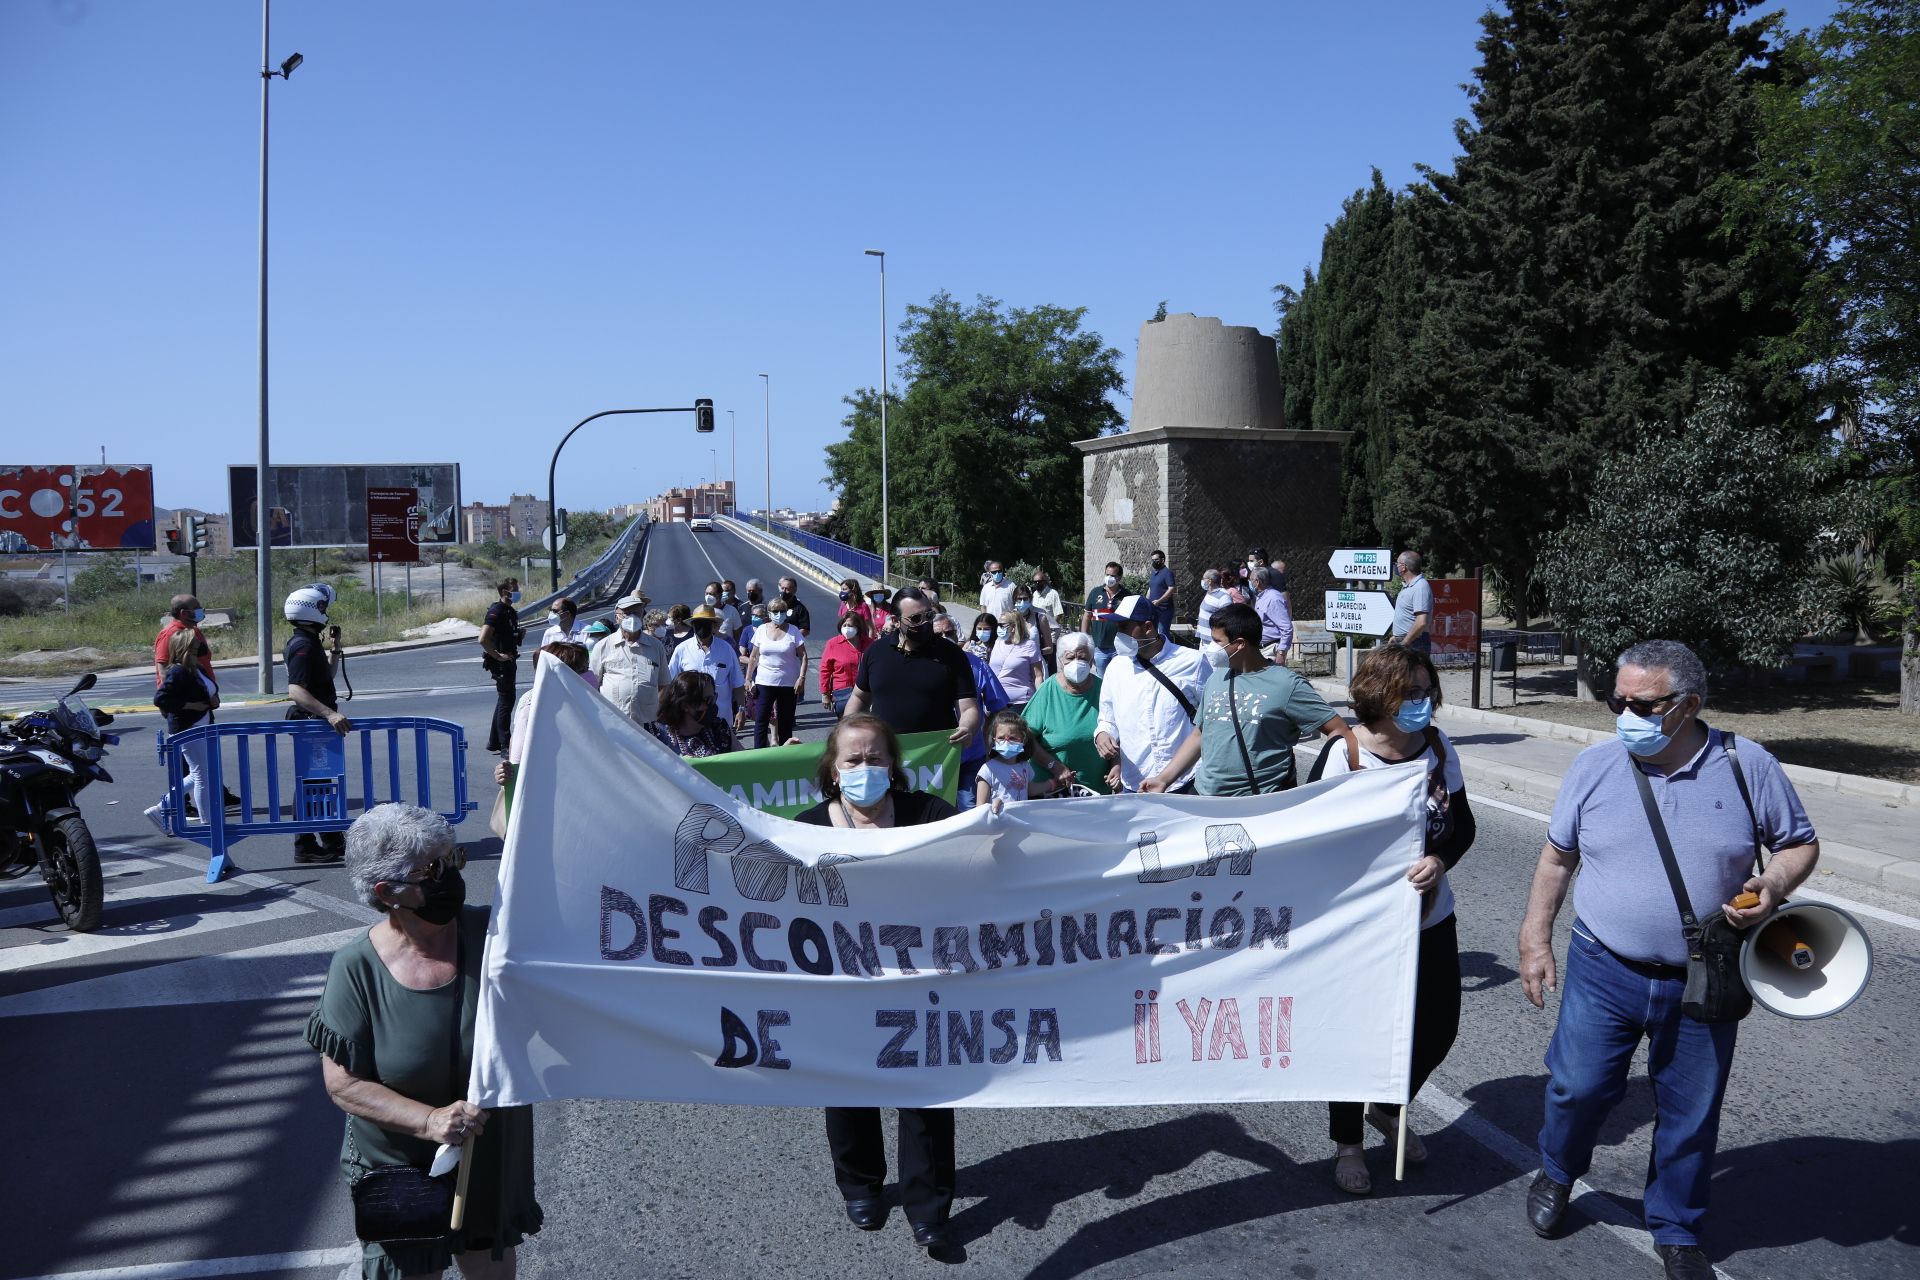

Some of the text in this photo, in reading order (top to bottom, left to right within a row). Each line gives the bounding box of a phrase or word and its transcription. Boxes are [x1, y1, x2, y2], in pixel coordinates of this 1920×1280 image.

[1354, 554, 1377, 563] RM-F35
[1344, 565, 1387, 575] CARTAGENA
[1336, 602, 1367, 610] APARECIDA
[1341, 612, 1362, 620] PUEBLA
[1331, 622, 1363, 631] SAN JAVIER
[1138, 823, 1257, 884] LA
[714, 1006, 791, 1070] DE
